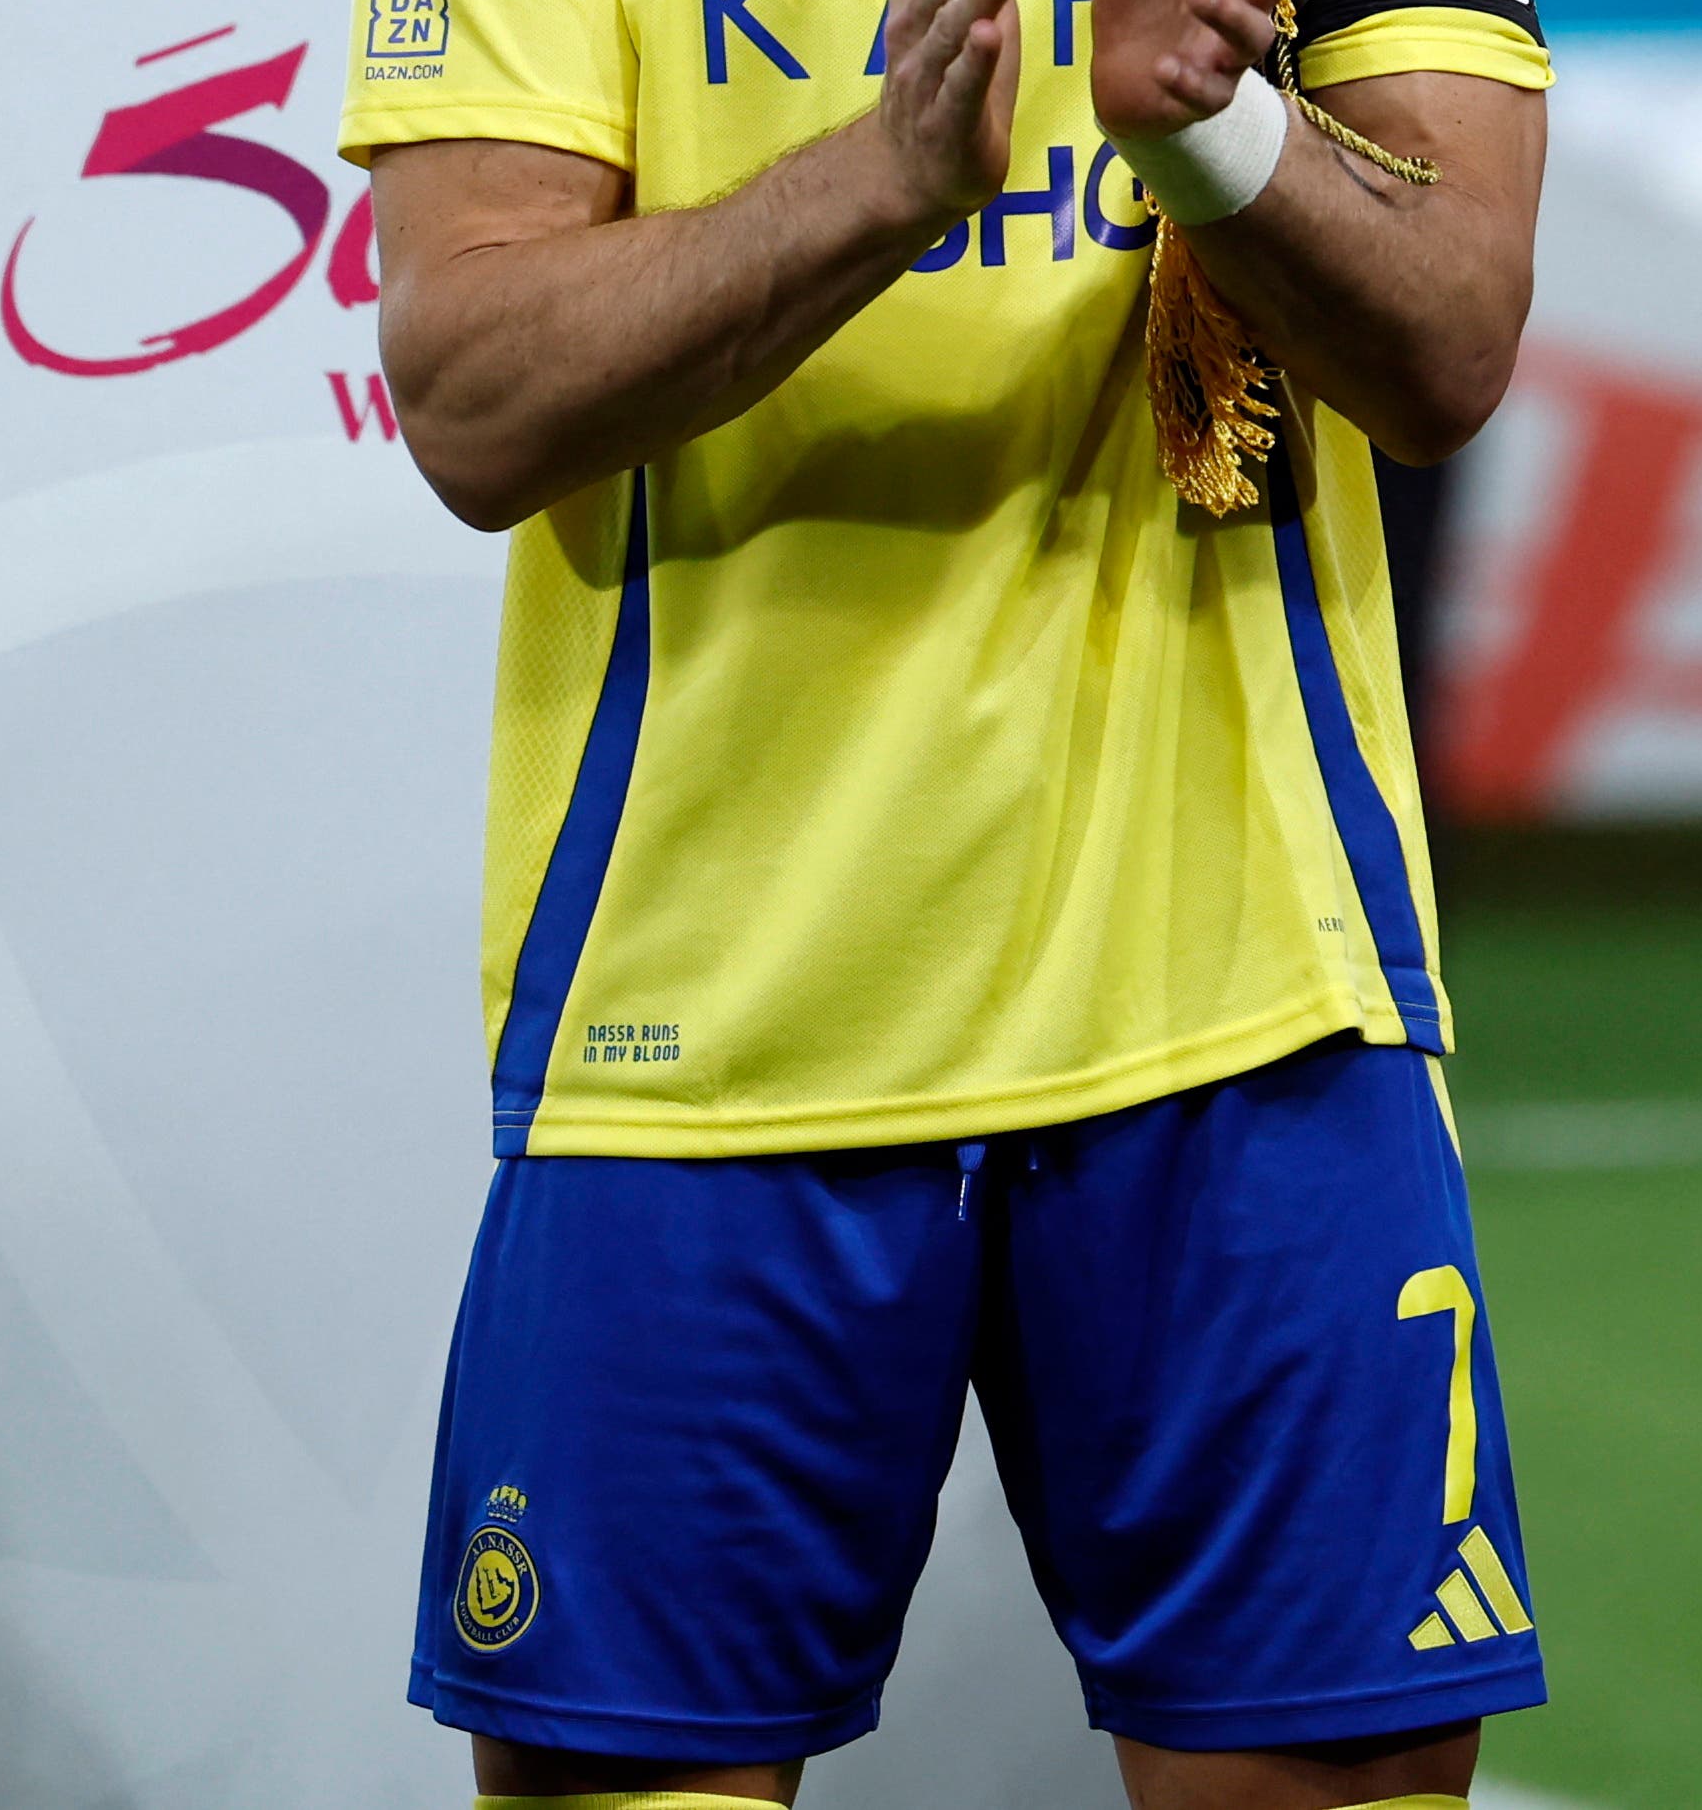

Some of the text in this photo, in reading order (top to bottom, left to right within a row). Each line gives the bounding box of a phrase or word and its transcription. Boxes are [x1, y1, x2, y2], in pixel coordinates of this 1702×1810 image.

[365, 64, 444, 81] DAZN.COM
[587, 1023, 680, 1043] NASSR RUNS
[583, 1043, 681, 1064] IN MY BLOOD
[1397, 1264, 1477, 1526] 7
[487, 1533, 529, 1576] NASSR
[459, 1600, 521, 1642] FOOTBALL CLUB
